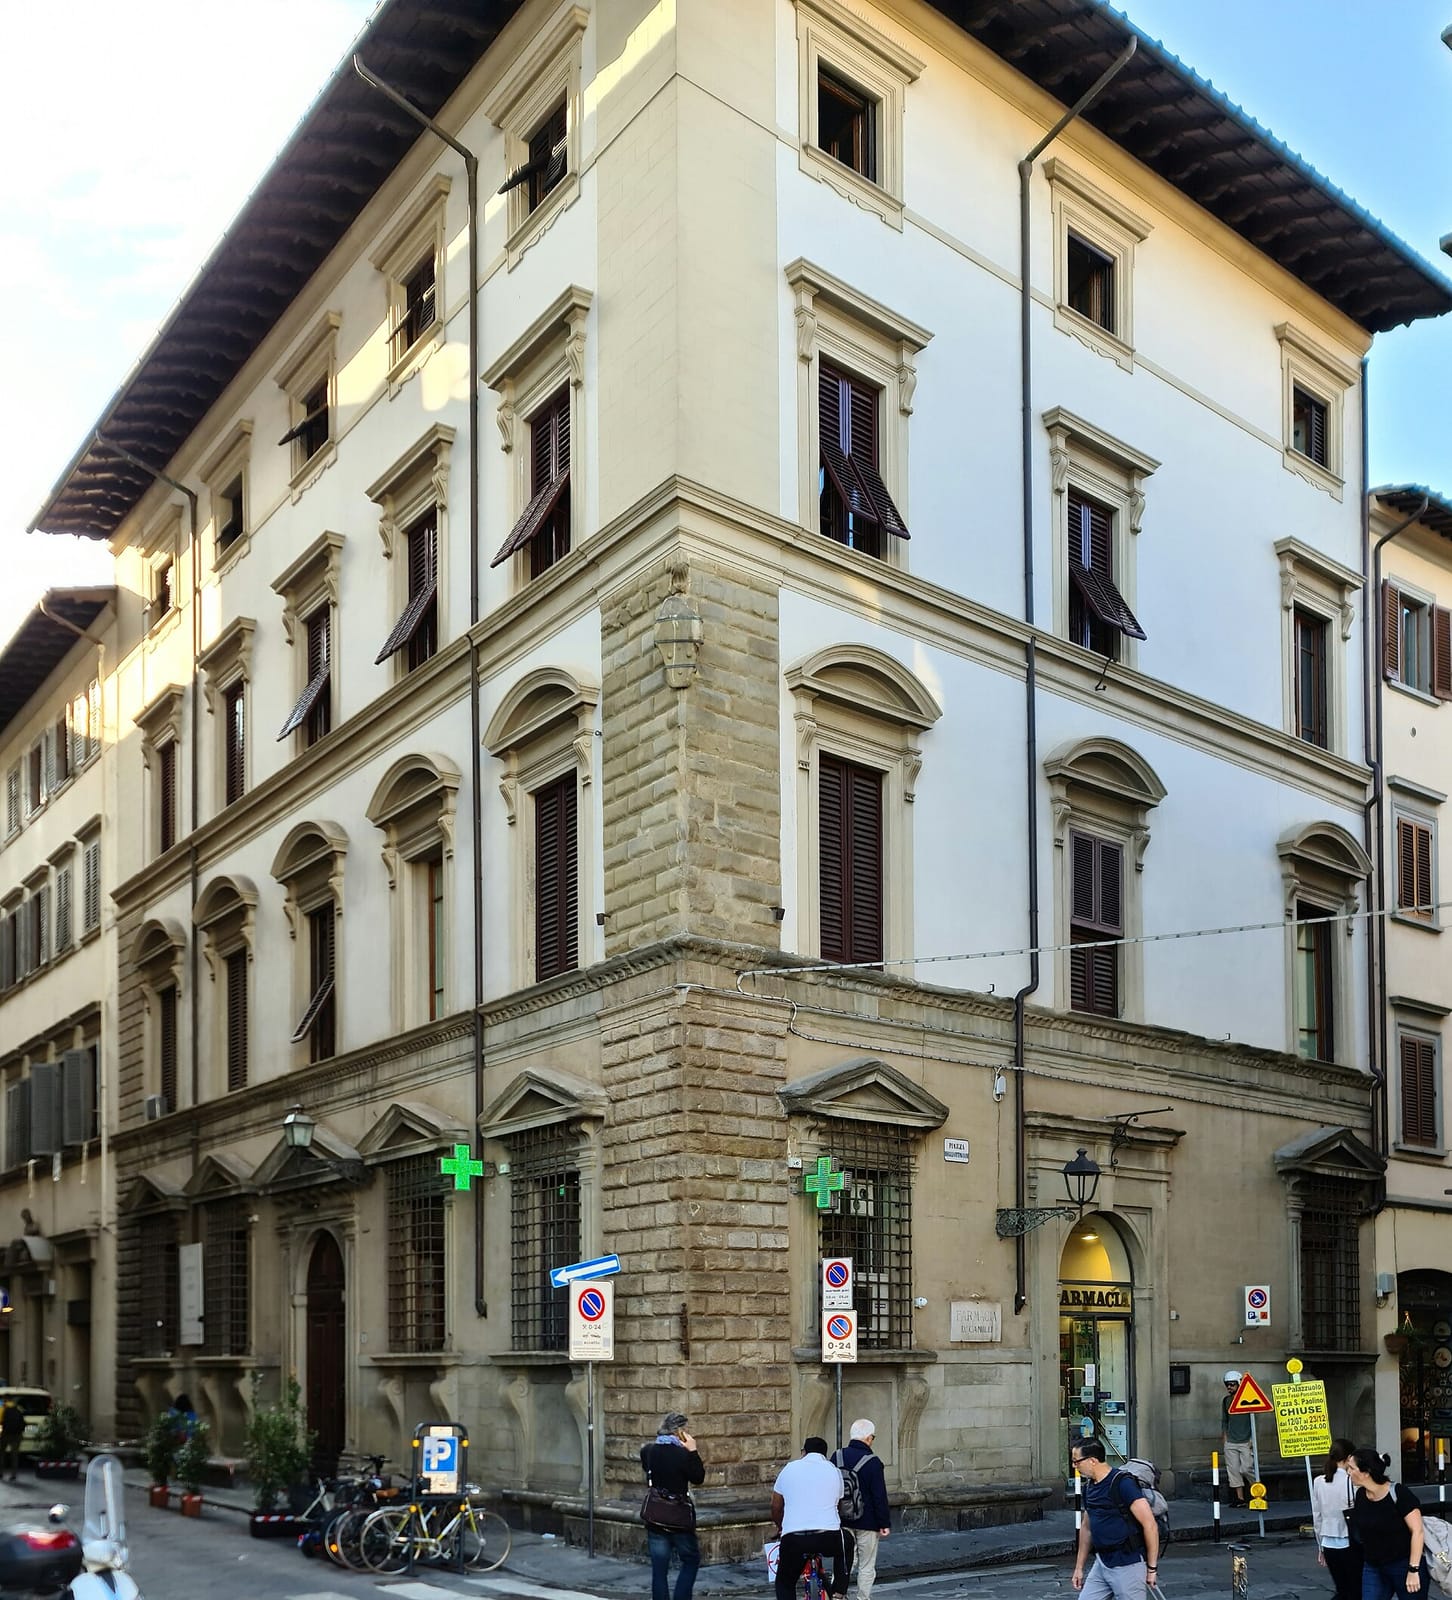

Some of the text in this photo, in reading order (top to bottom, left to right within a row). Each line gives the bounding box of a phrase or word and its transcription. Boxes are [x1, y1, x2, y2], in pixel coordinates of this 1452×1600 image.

[1060, 1289, 1130, 1307] ARMACIA
[1287, 1384, 1322, 1392] Palazzuolo
[1280, 1405, 1322, 1416] CHIUSE
[1308, 1414, 1326, 1423] 23/12
[430, 1441, 452, 1470] P
